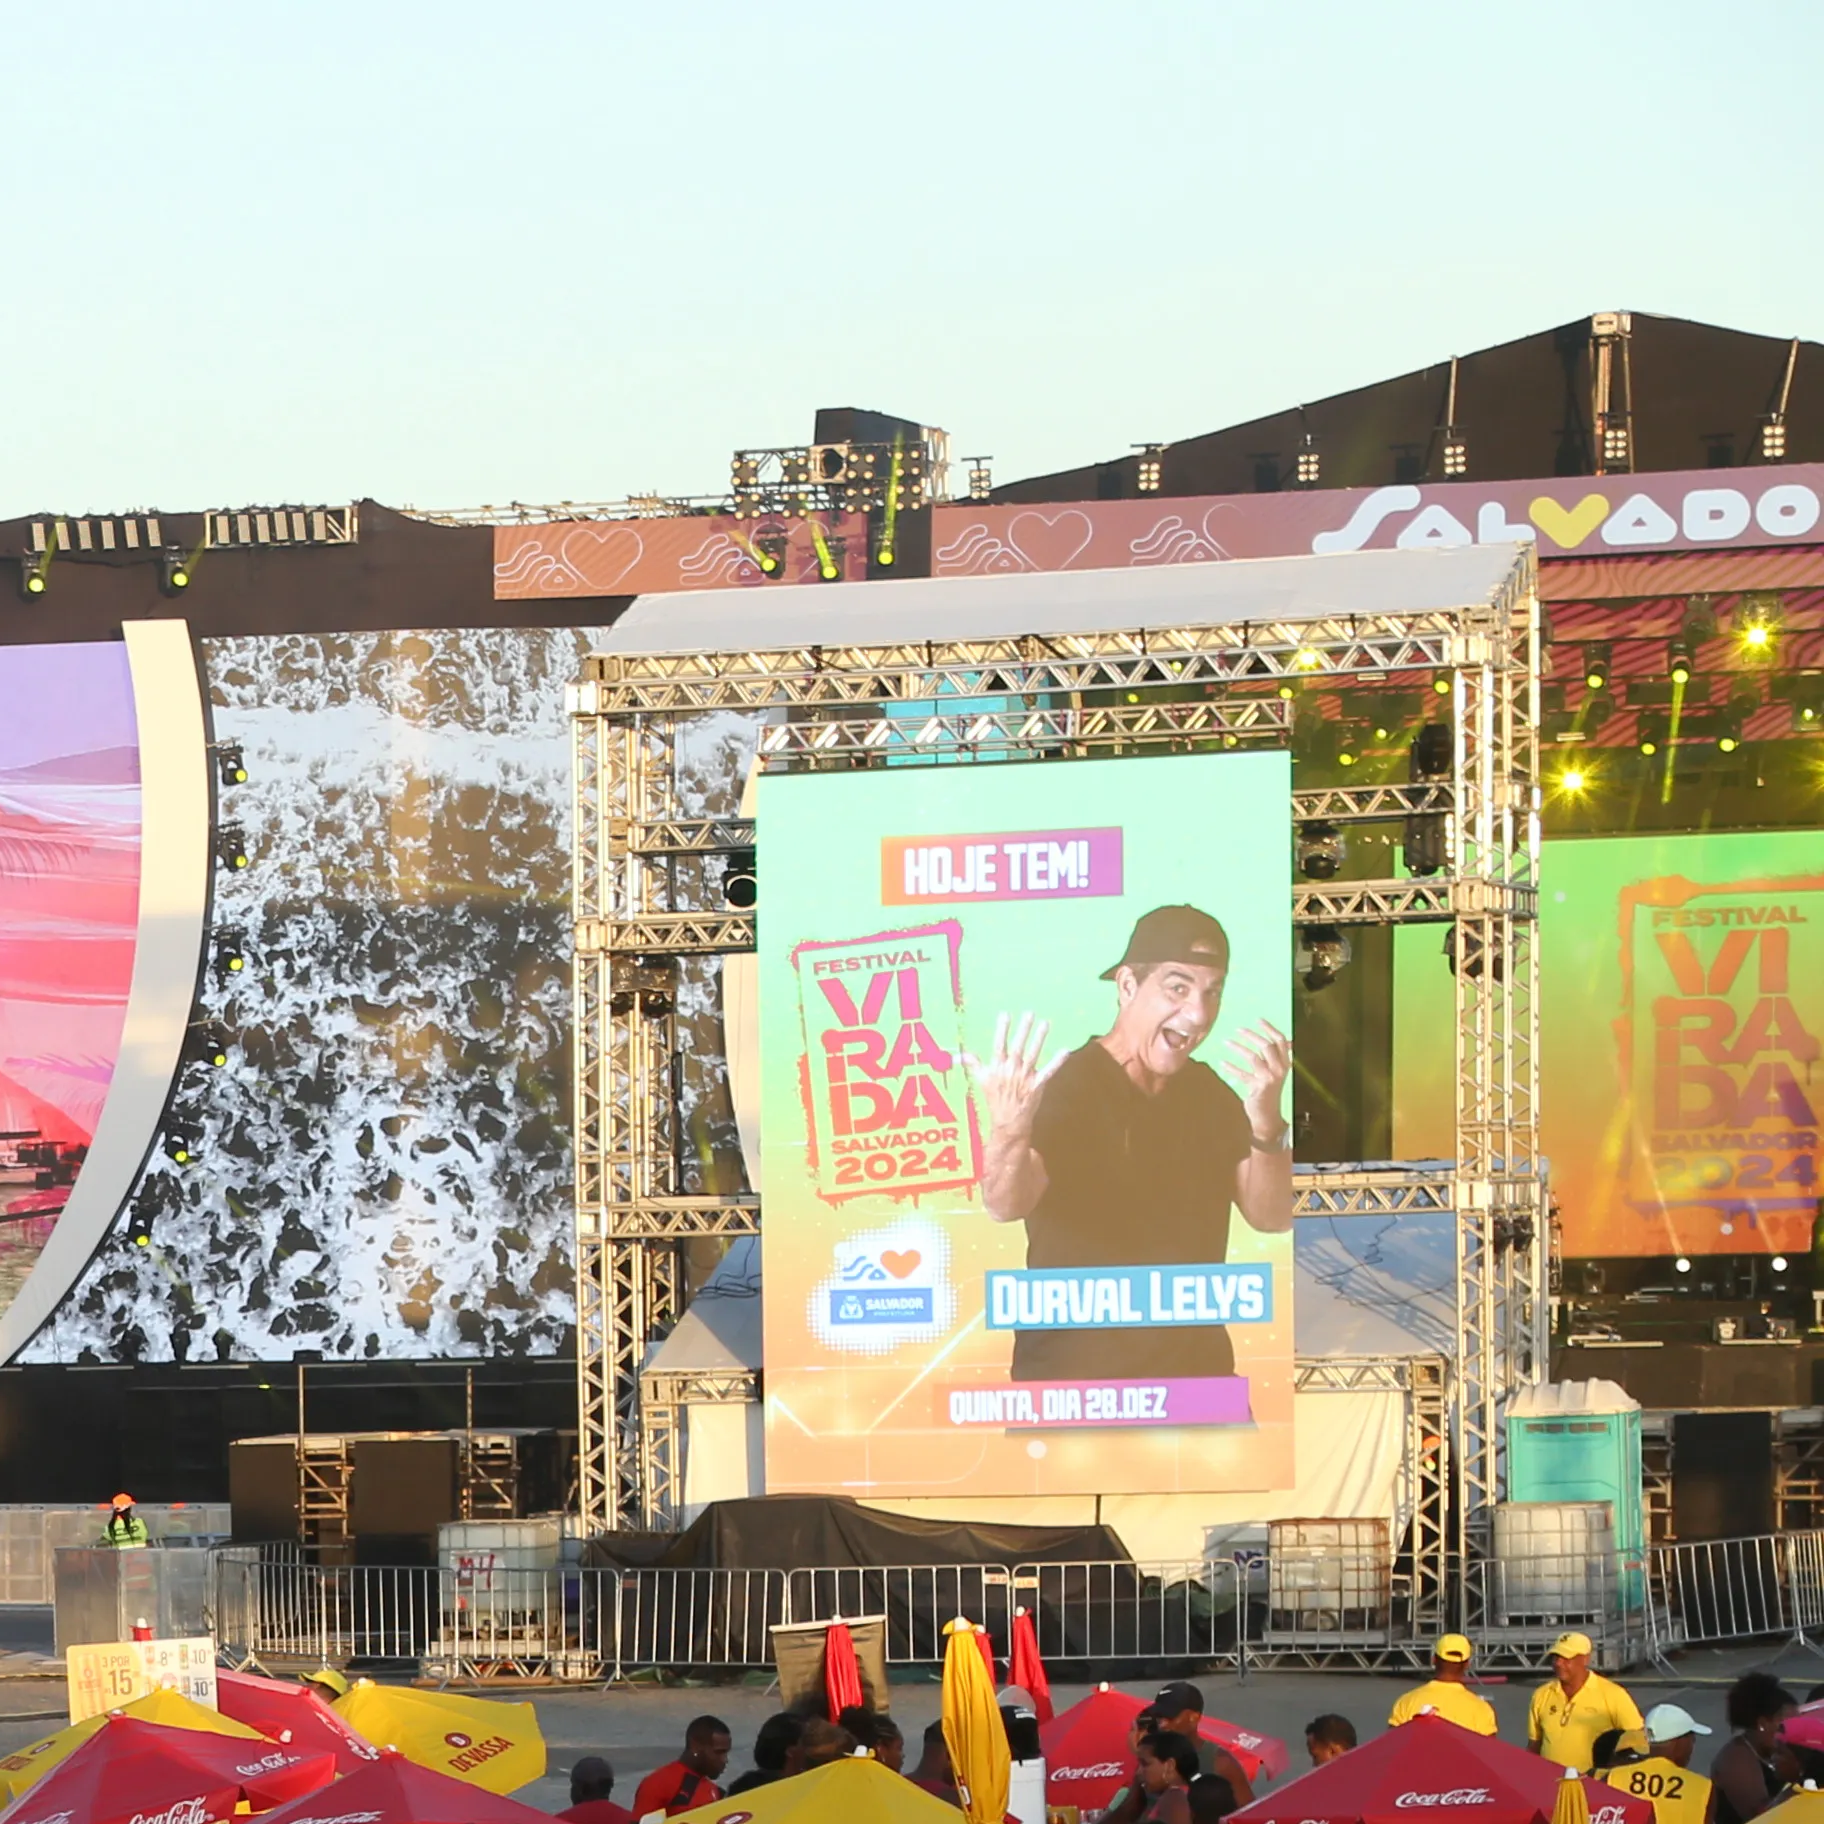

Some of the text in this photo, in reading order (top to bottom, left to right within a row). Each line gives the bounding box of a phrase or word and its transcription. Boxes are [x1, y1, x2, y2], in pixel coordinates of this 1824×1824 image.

[904, 840, 1089, 895] HOJE TEM!
[1652, 906, 1807, 929] FESTIVAL
[812, 949, 931, 976] FESTIVAL
[831, 1126, 959, 1154] SALVADOR
[834, 1152, 962, 1185] 2024
[1656, 1155, 1818, 1190] 2024
[864, 1296, 925, 1311] SALVADOR
[991, 1269, 1266, 1326] DURVAL LELYS
[949, 1387, 1168, 1425] QUINTA, DIA 28.DEZ
[448, 1736, 515, 1773] DEVASSA
[1050, 1762, 1120, 1782] Coca-Cola
[1628, 1770, 1683, 1800] 802
[1395, 1788, 1491, 1808] Coca-Cola
